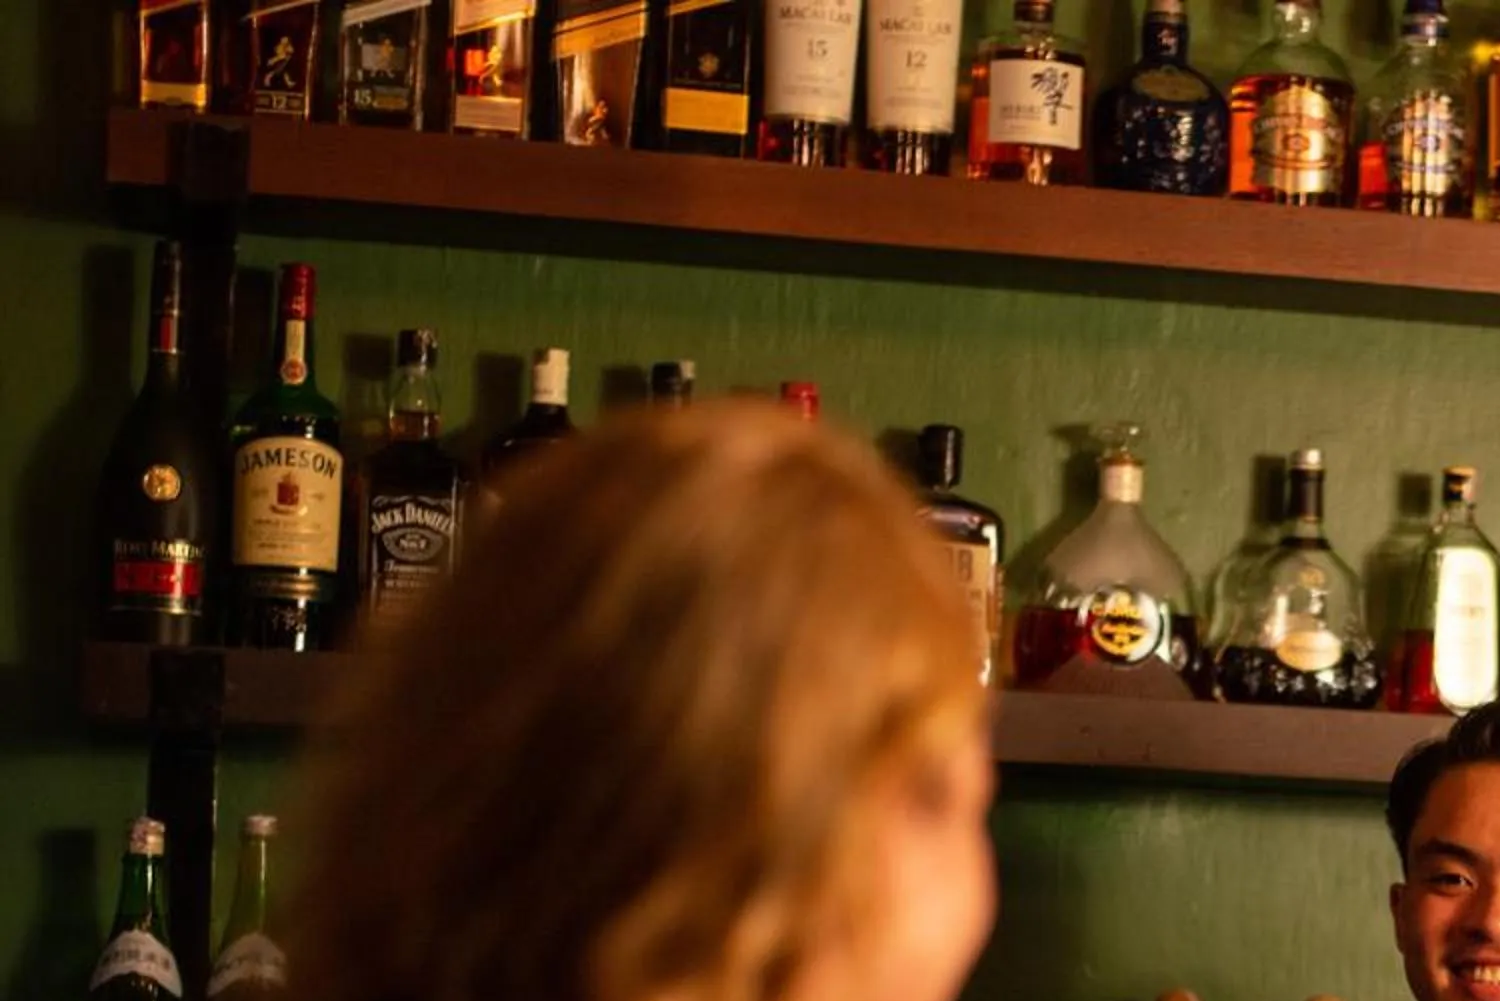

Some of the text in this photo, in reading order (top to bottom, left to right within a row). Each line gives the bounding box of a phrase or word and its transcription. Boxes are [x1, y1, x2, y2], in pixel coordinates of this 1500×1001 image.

[807, 36, 827, 60] 15
[905, 48, 927, 68] 12
[271, 94, 287, 109] 12
[240, 446, 337, 479] JAMESON
[371, 507, 403, 534] JACK
